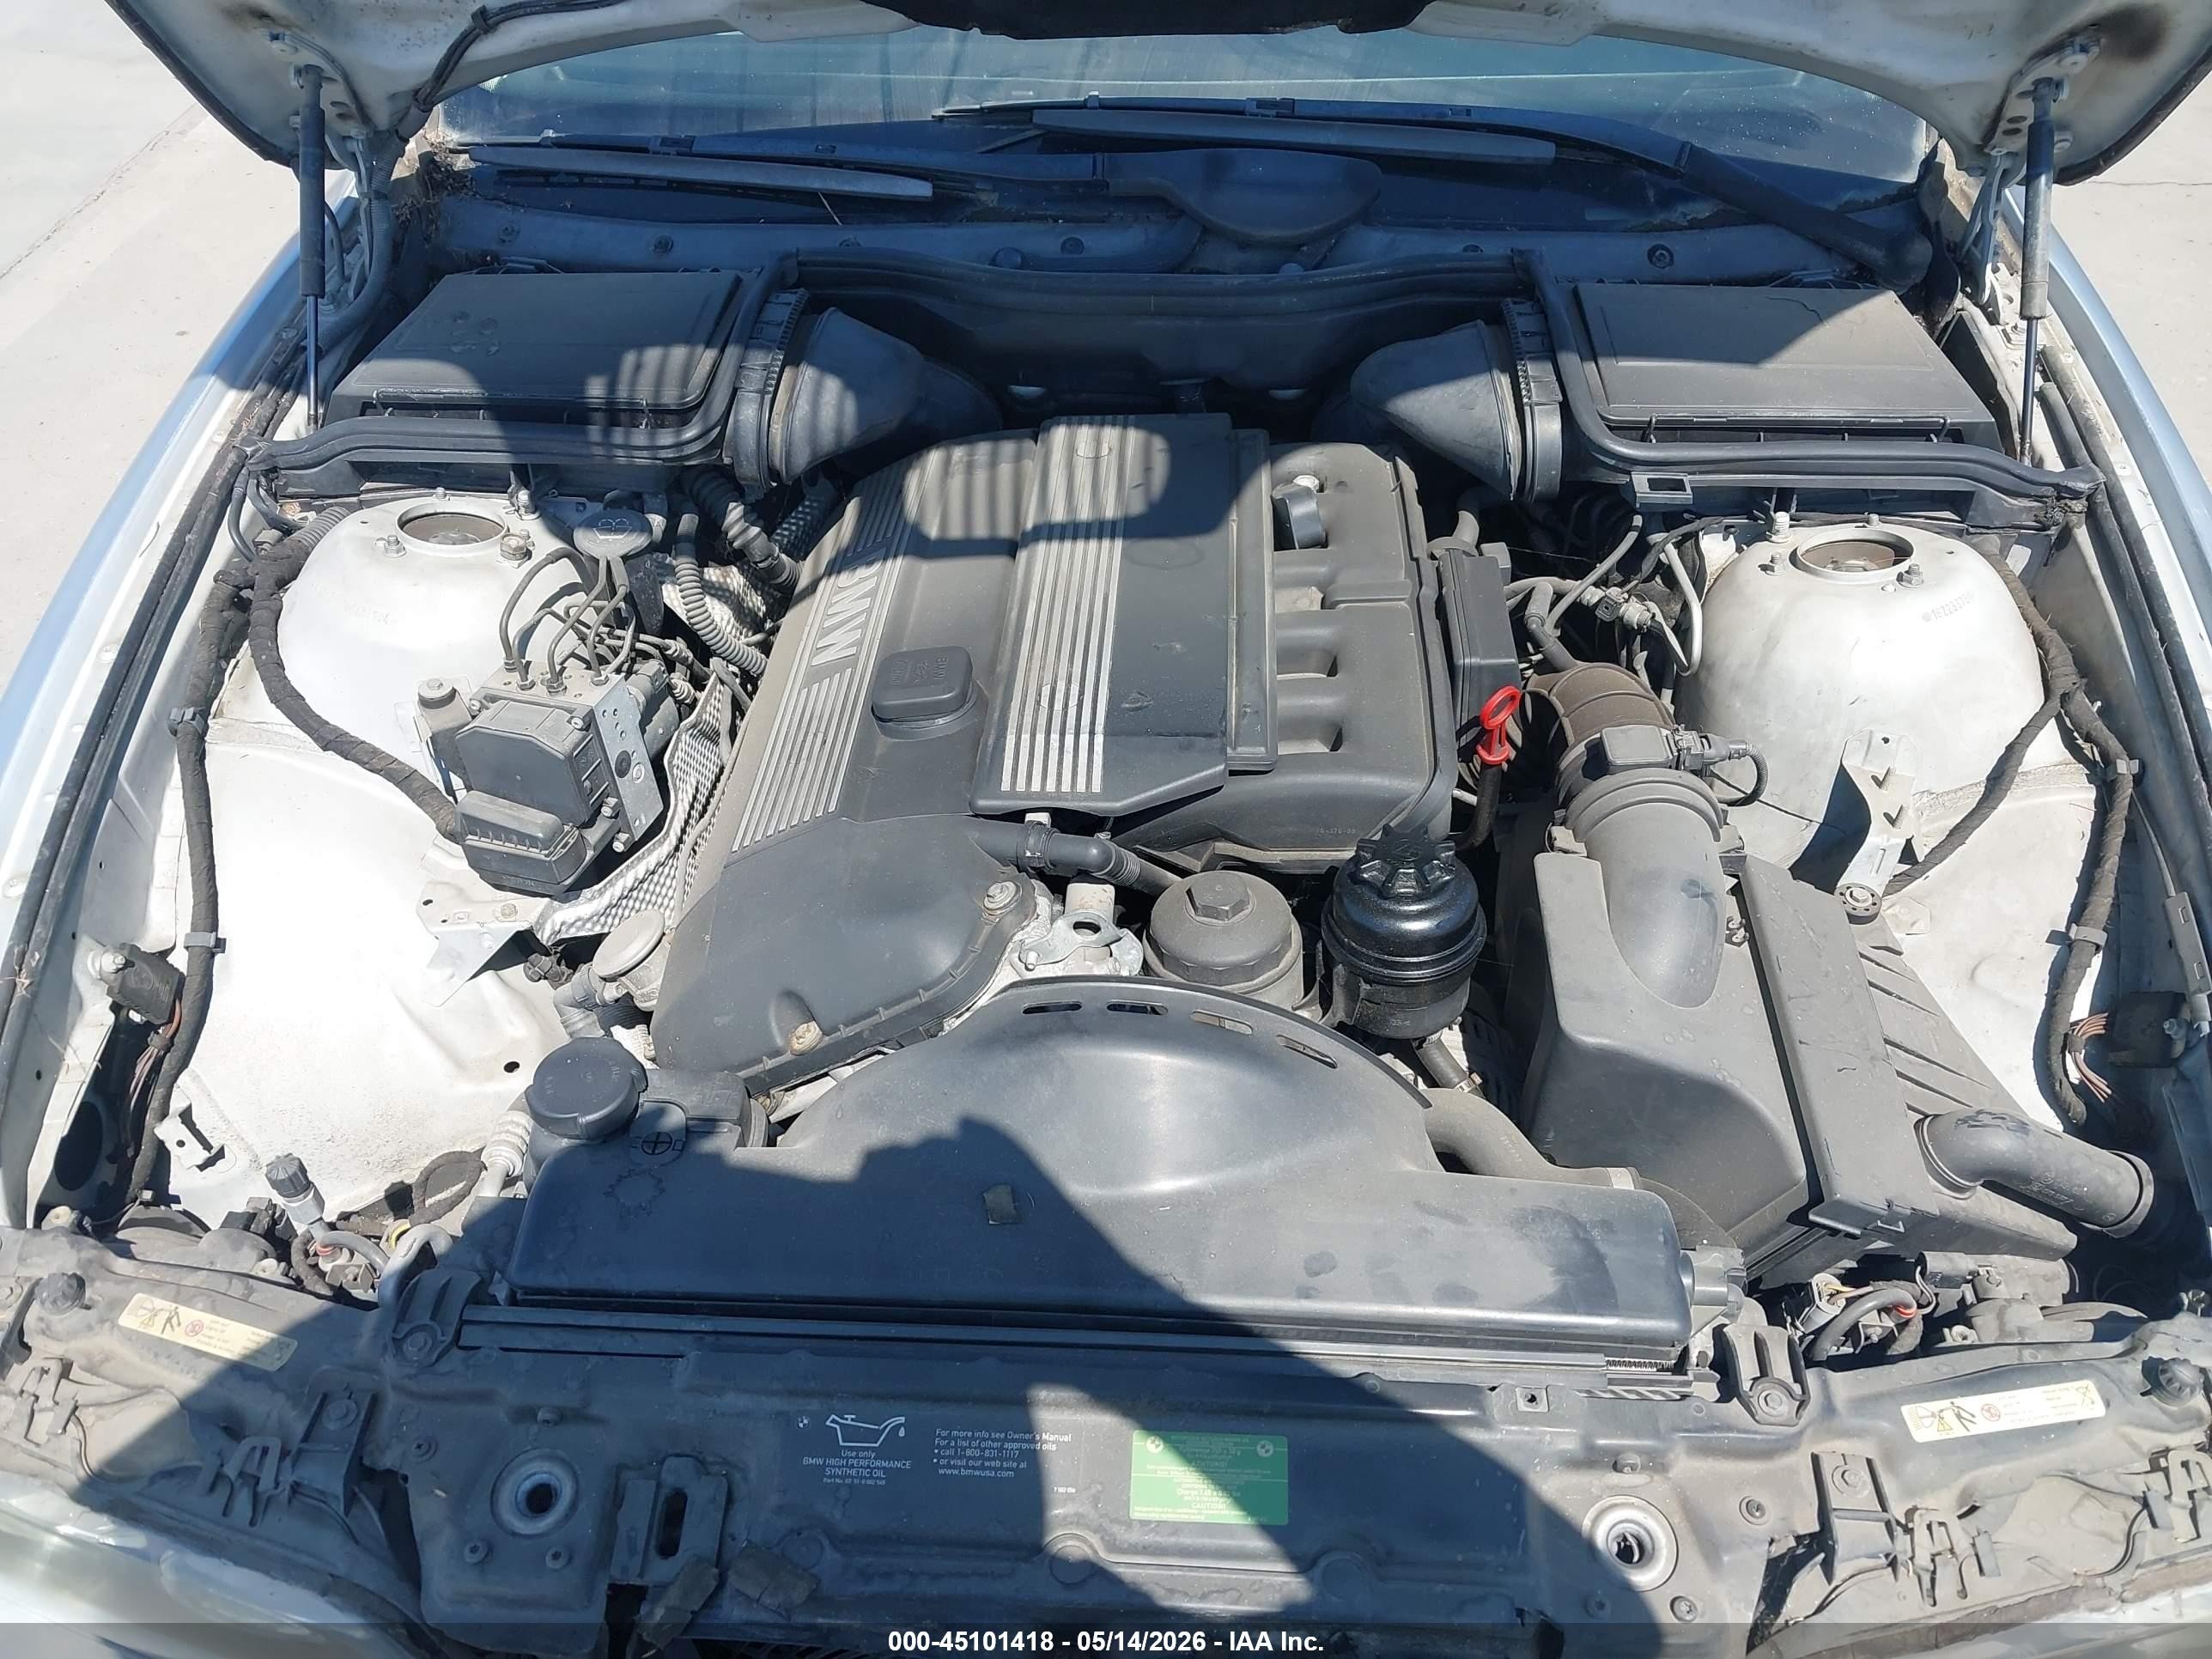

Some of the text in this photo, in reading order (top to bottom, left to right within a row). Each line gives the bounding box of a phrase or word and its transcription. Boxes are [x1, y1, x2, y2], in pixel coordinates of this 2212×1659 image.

[811, 547, 887, 667] BMW
[936, 1428, 951, 1437] For
[974, 1430, 990, 1439] info
[1006, 1431, 1041, 1441] Owner's
[1042, 1432, 1072, 1443] Manual
[934, 1437, 949, 1446] For
[957, 1438, 969, 1447] list
[970, 1438, 979, 1448] of
[980, 1439, 1001, 1449] other
[1003, 1440, 1041, 1451] approved
[1042, 1442, 1058, 1451] oils
[858, 1449, 876, 1459] only
[956, 1448, 1019, 1458] 1-800-831-1117
[802, 1456, 913, 1469] BMW HIGH PERFORMANCE
[950, 1457, 966, 1466] visit
[984, 1459, 1000, 1468] web
[1002, 1460, 1017, 1468] site
[1018, 1460, 1027, 1468] at
[824, 1467, 886, 1478] SYNTHETIC OIL
[938, 1467, 1015, 1478] www.bmwusa.com
